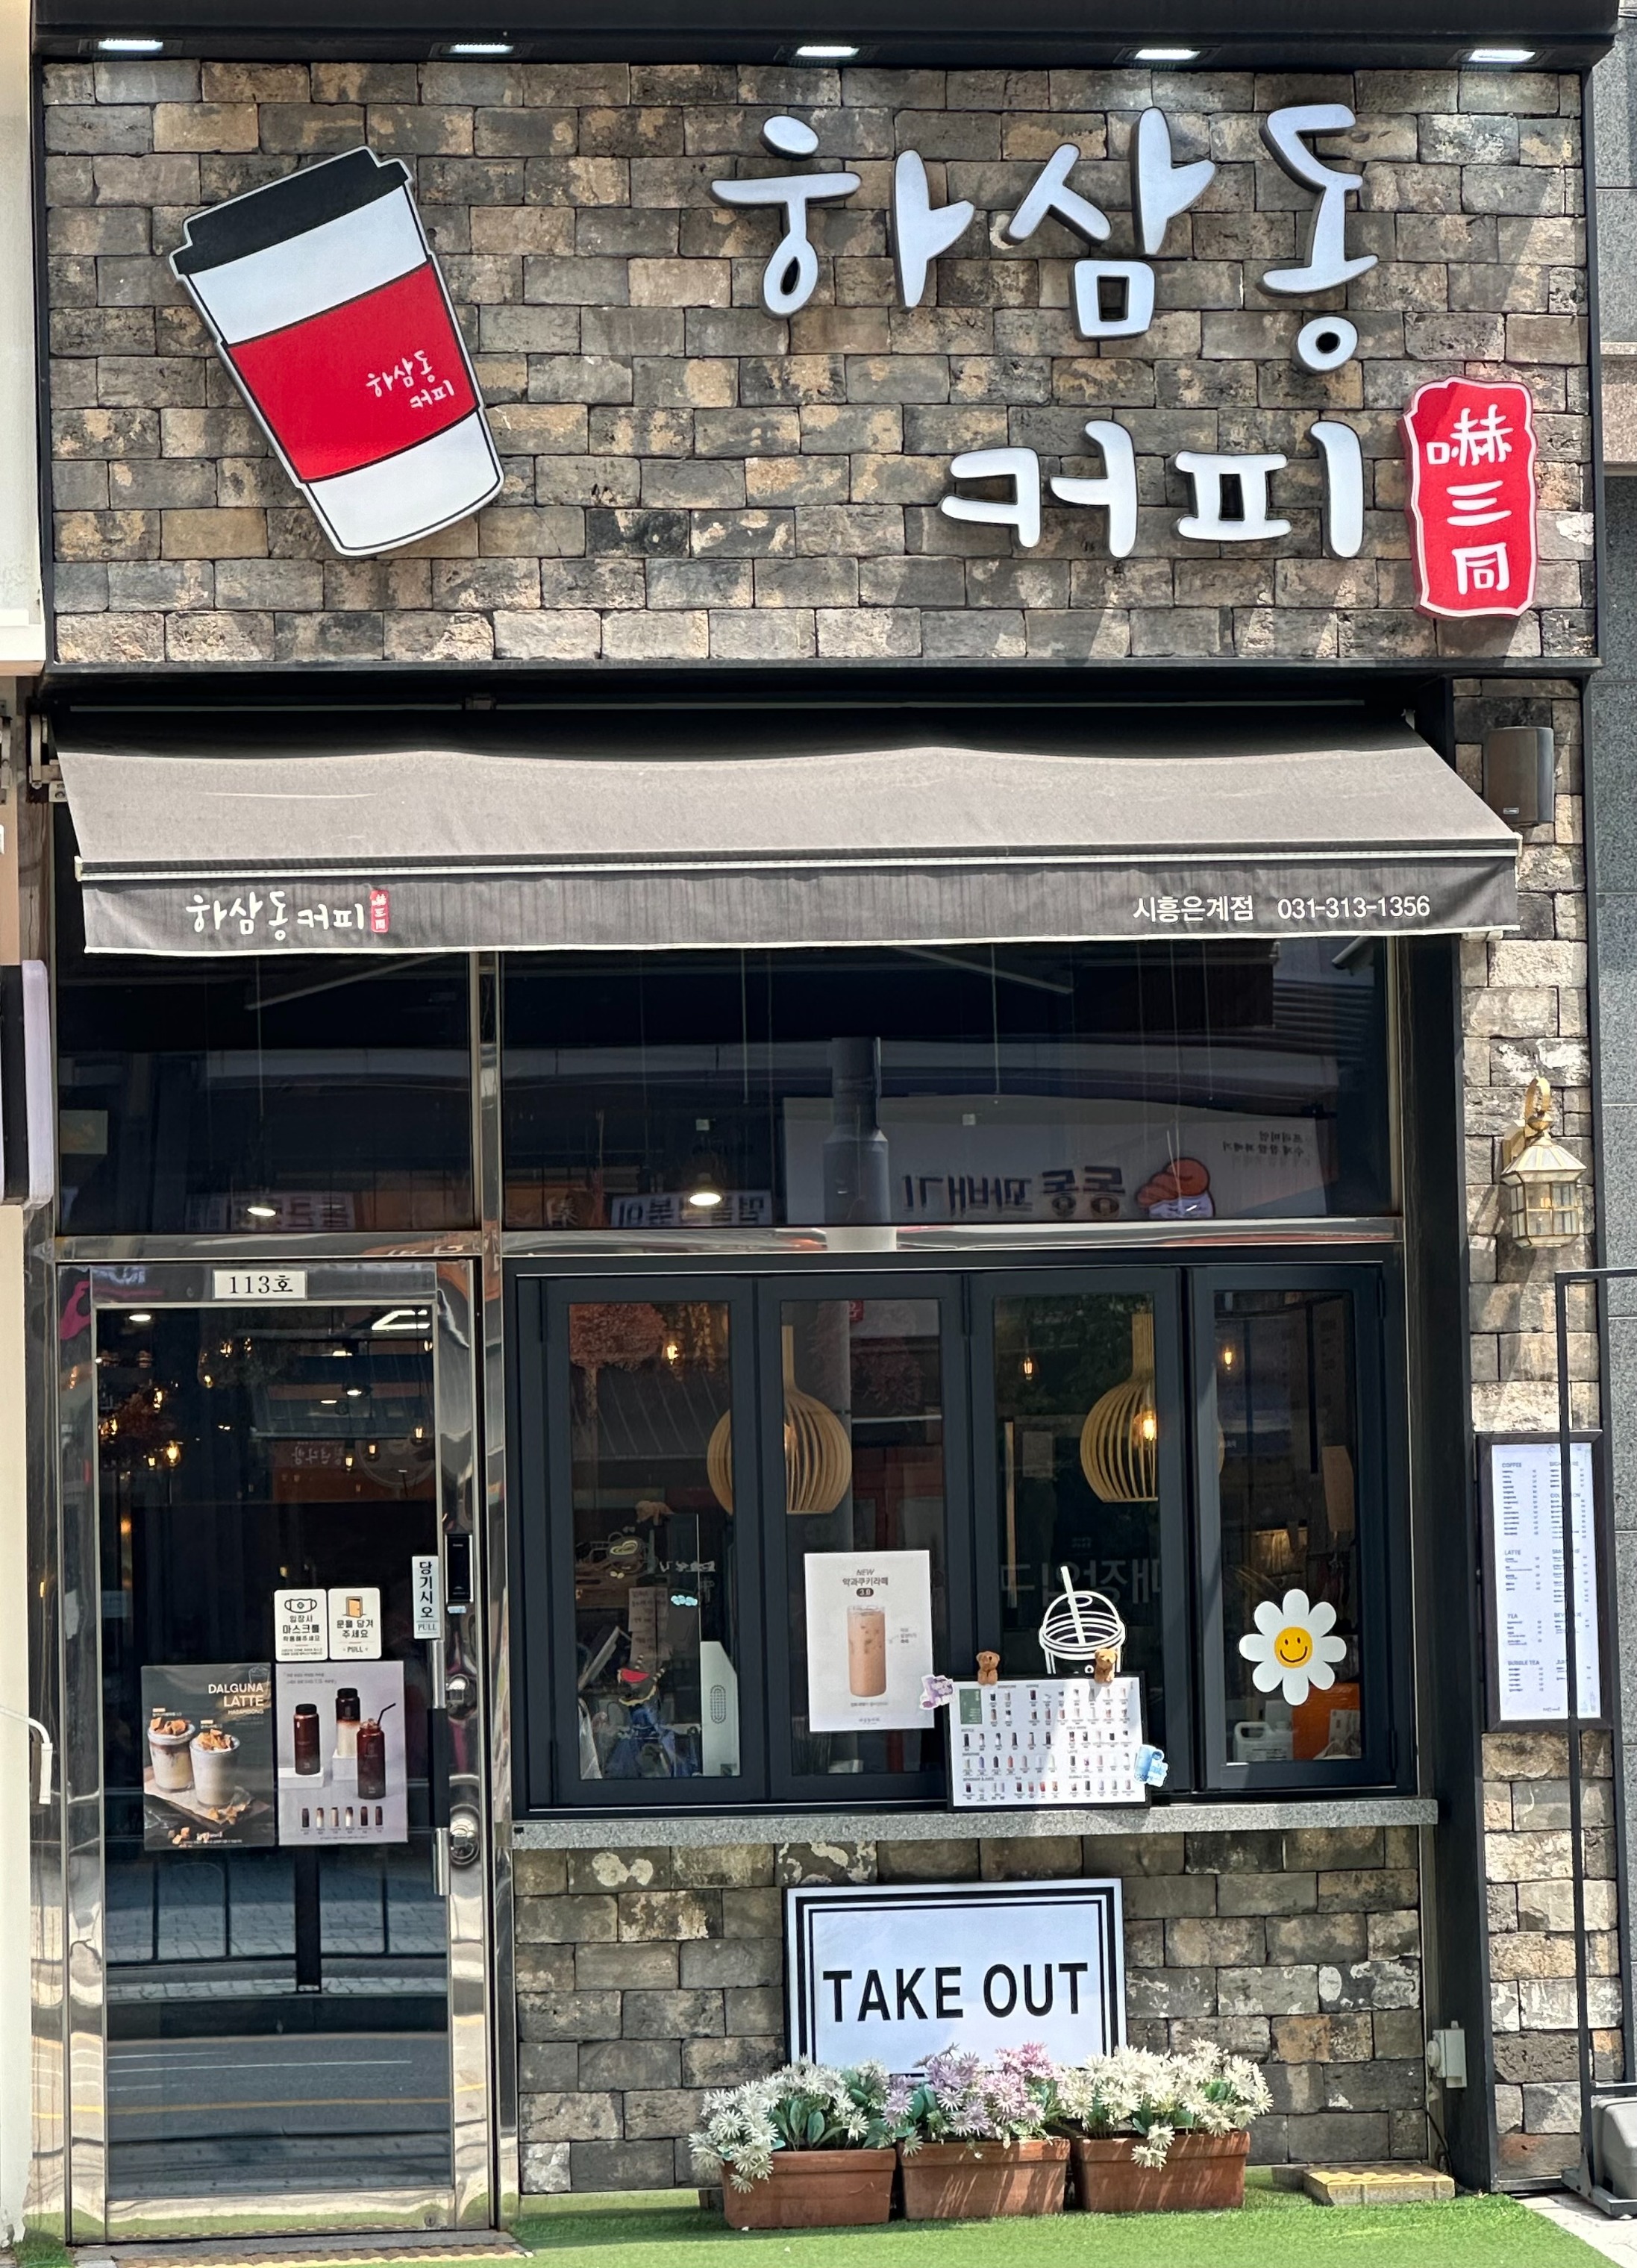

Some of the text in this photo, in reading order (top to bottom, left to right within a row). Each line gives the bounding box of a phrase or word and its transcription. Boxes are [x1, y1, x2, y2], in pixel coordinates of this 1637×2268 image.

[710, 103, 1379, 373] 하삼동
[366, 349, 436, 398] 하삼동
[410, 380, 455, 408] 커피
[939, 419, 1364, 559] 커피
[1133, 895, 1430, 922] 시흥은계점 031-313-1356
[230, 1275, 293, 1294] 113호
[419, 1561, 433, 1618] 당기시오
[283, 1624, 319, 1634] 마스크를
[342, 1630, 368, 1638] 주세요
[418, 1623, 436, 1632] PULL
[208, 1682, 264, 1694] DALGUNA
[224, 1695, 264, 1707] LATTE
[823, 1962, 1088, 2023] TAKE OUT
